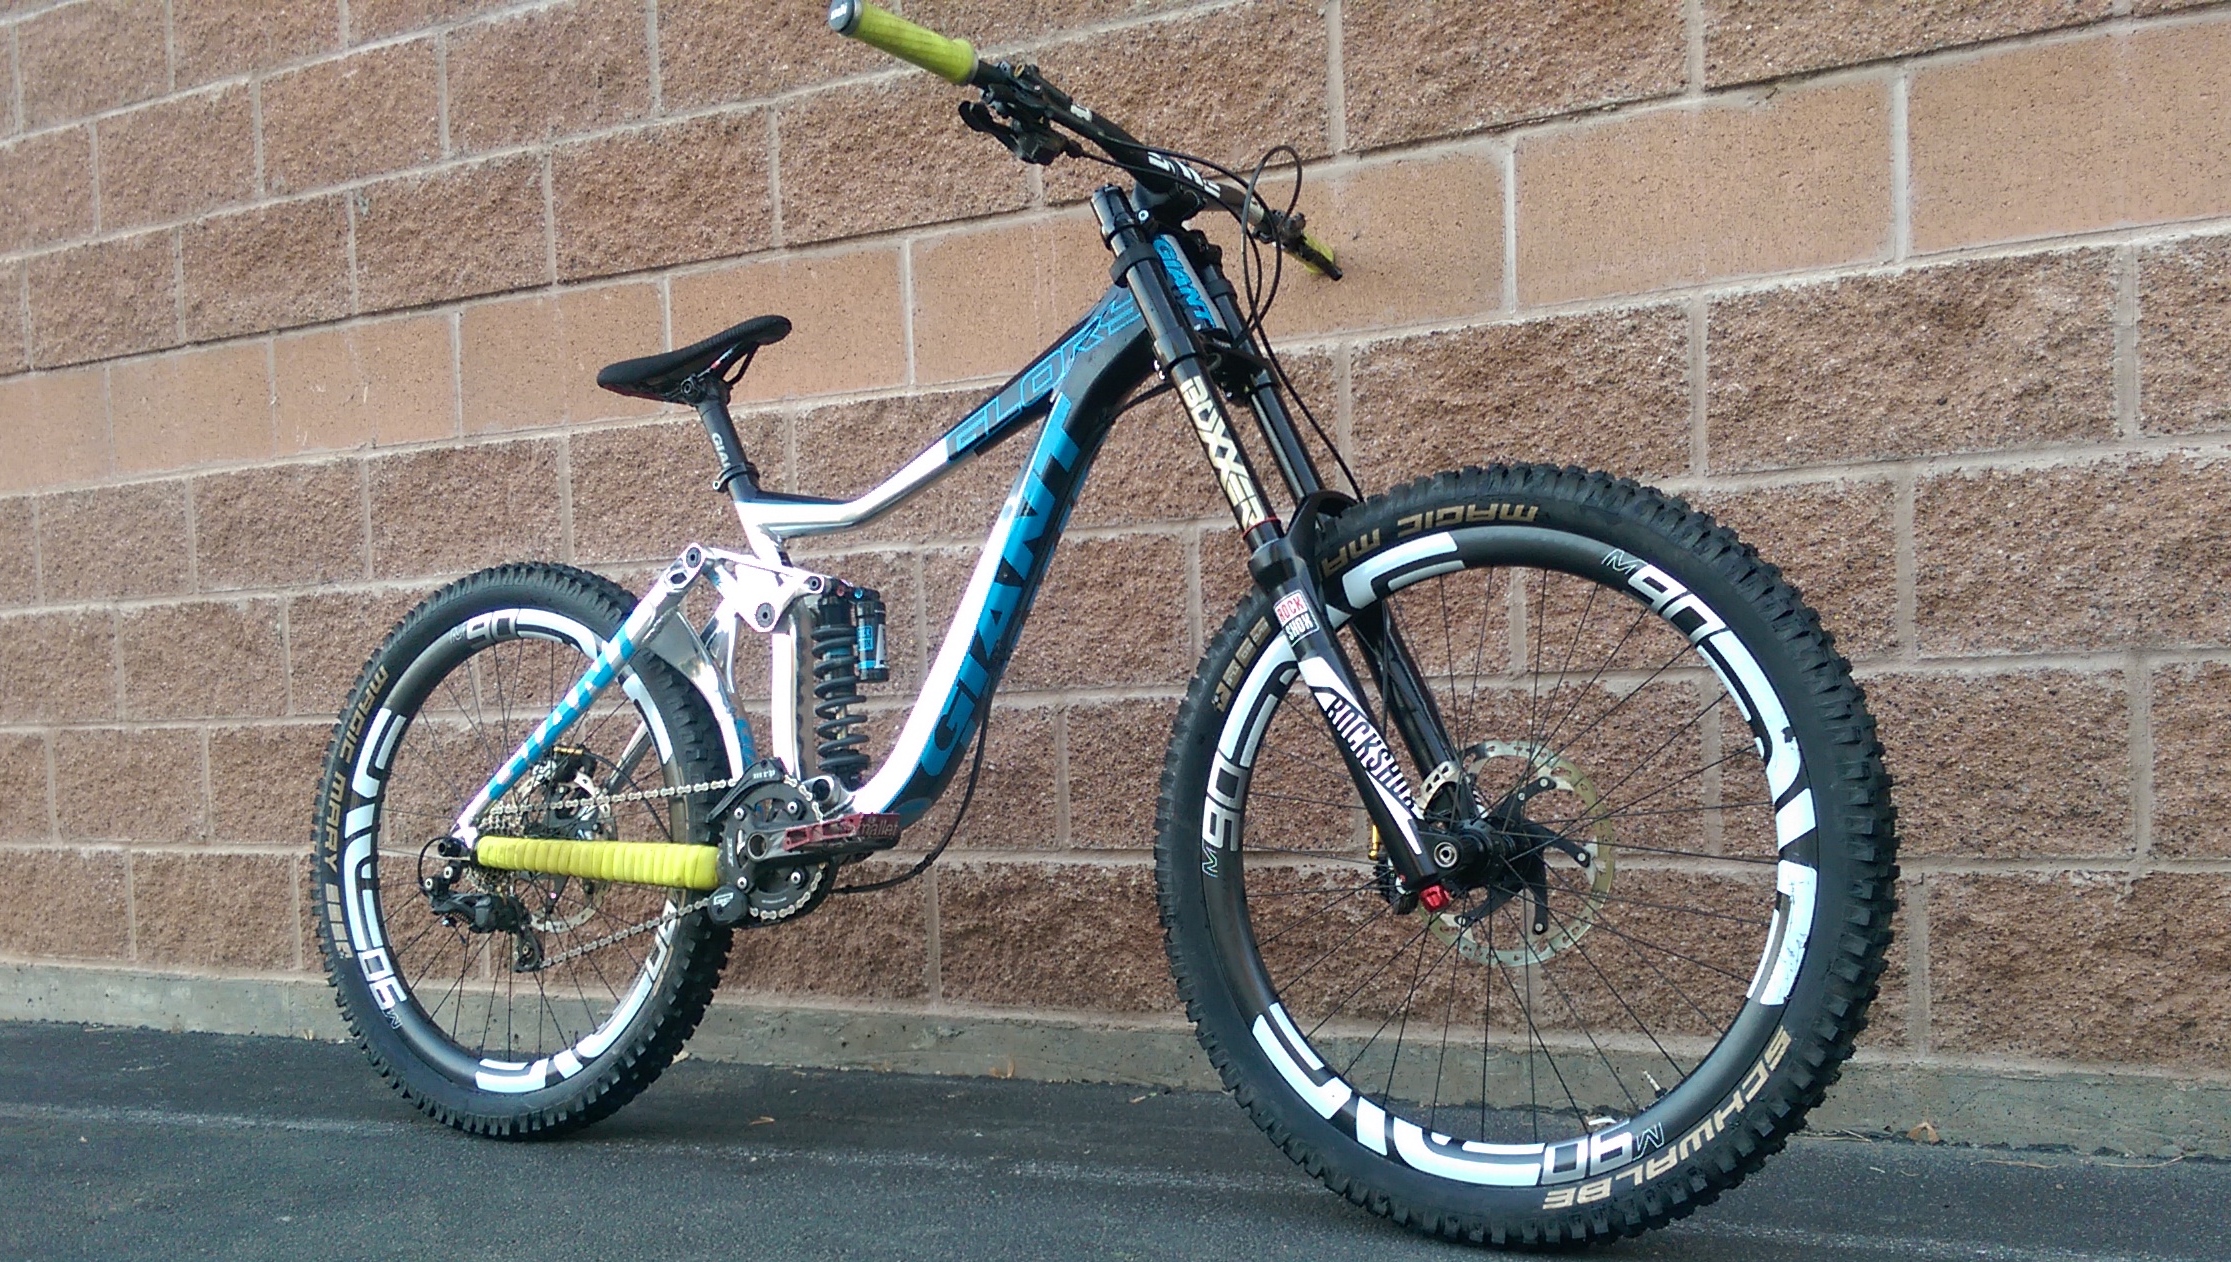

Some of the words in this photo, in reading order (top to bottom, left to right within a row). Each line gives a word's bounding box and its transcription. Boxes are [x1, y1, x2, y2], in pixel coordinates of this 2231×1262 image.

[1153, 238, 1217, 328] GIANT
[1180, 375, 1266, 531] BOXXER
[1320, 527, 1381, 578] MA
[1397, 503, 1538, 538] MAGIC
[920, 392, 1080, 777] GIANT
[1277, 597, 1305, 622] ROCK
[1285, 613, 1315, 641] SHOX
[340, 664, 389, 764] MAGIC
[753, 769, 776, 780] mrp
[324, 771, 346, 873] MARY
[861, 820, 898, 836] mallet
[1542, 1025, 1792, 1210] SCHWALBE
